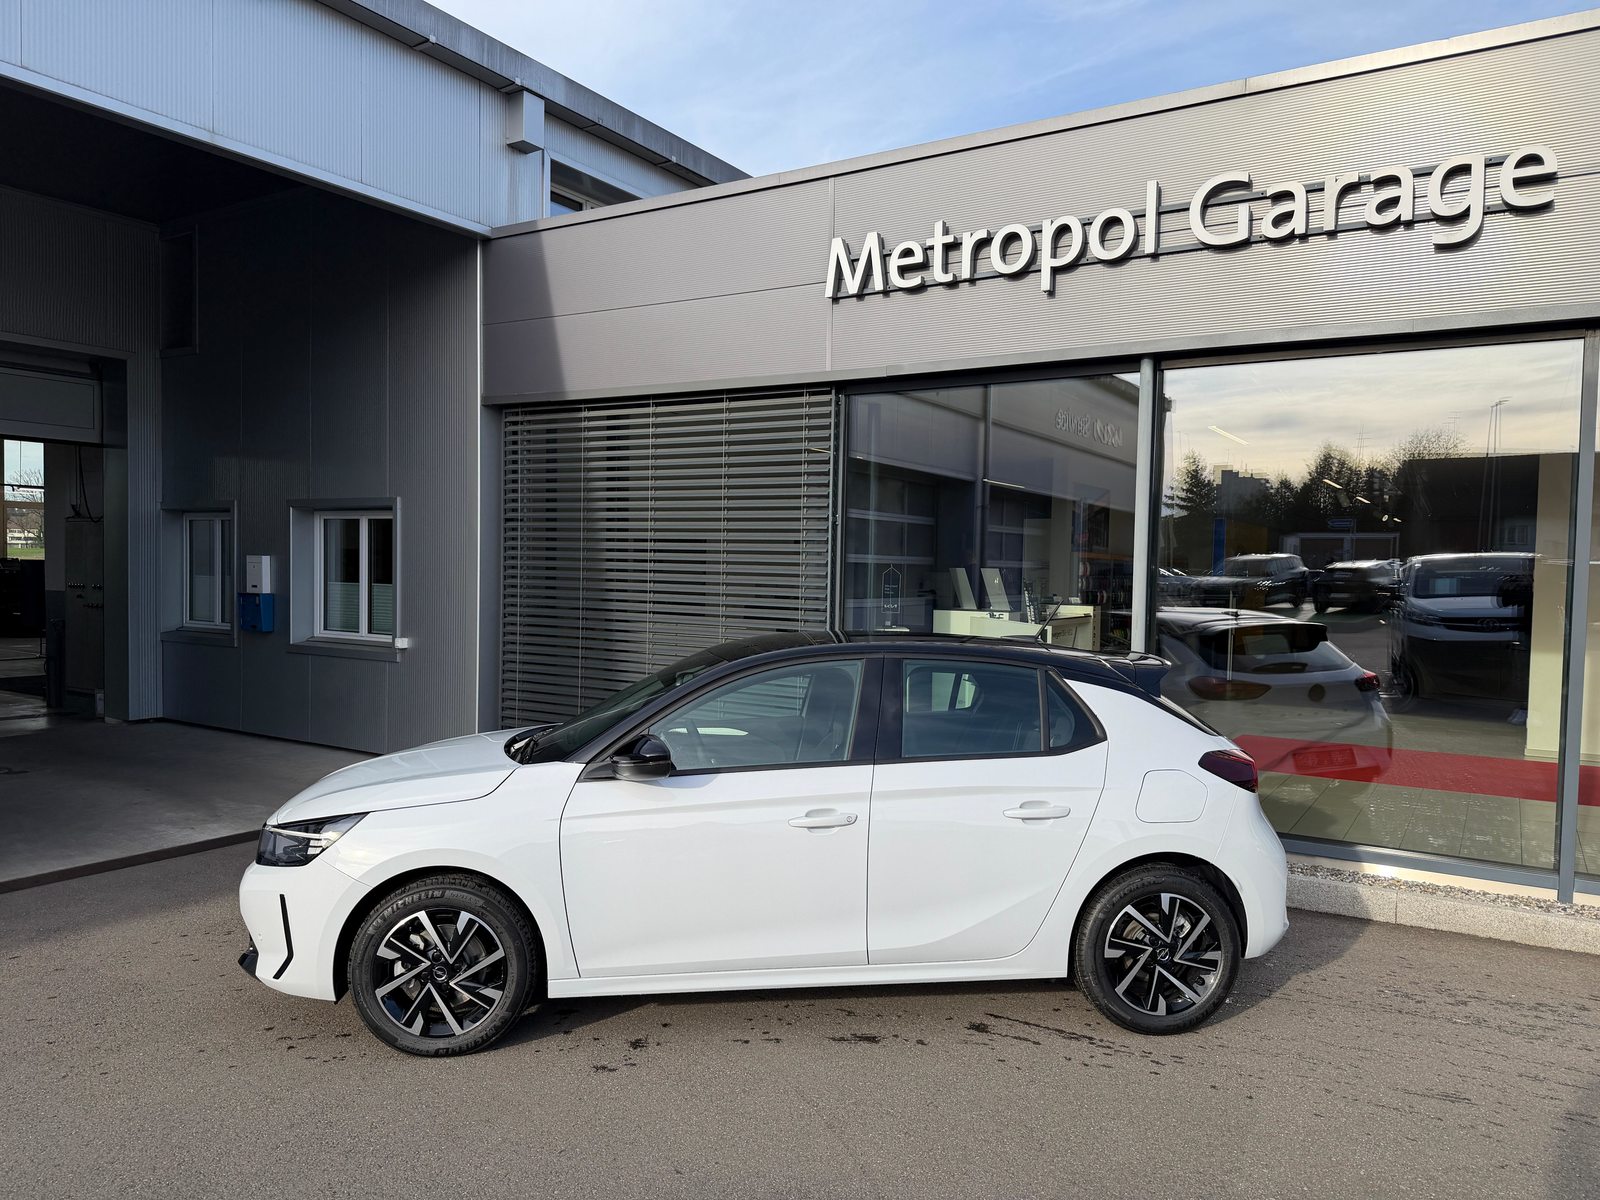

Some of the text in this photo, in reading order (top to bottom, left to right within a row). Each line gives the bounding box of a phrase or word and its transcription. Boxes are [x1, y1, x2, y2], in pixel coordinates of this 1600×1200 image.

[825, 144, 1559, 298] Metropol Garage
[384, 890, 443, 917] MICHELIN
